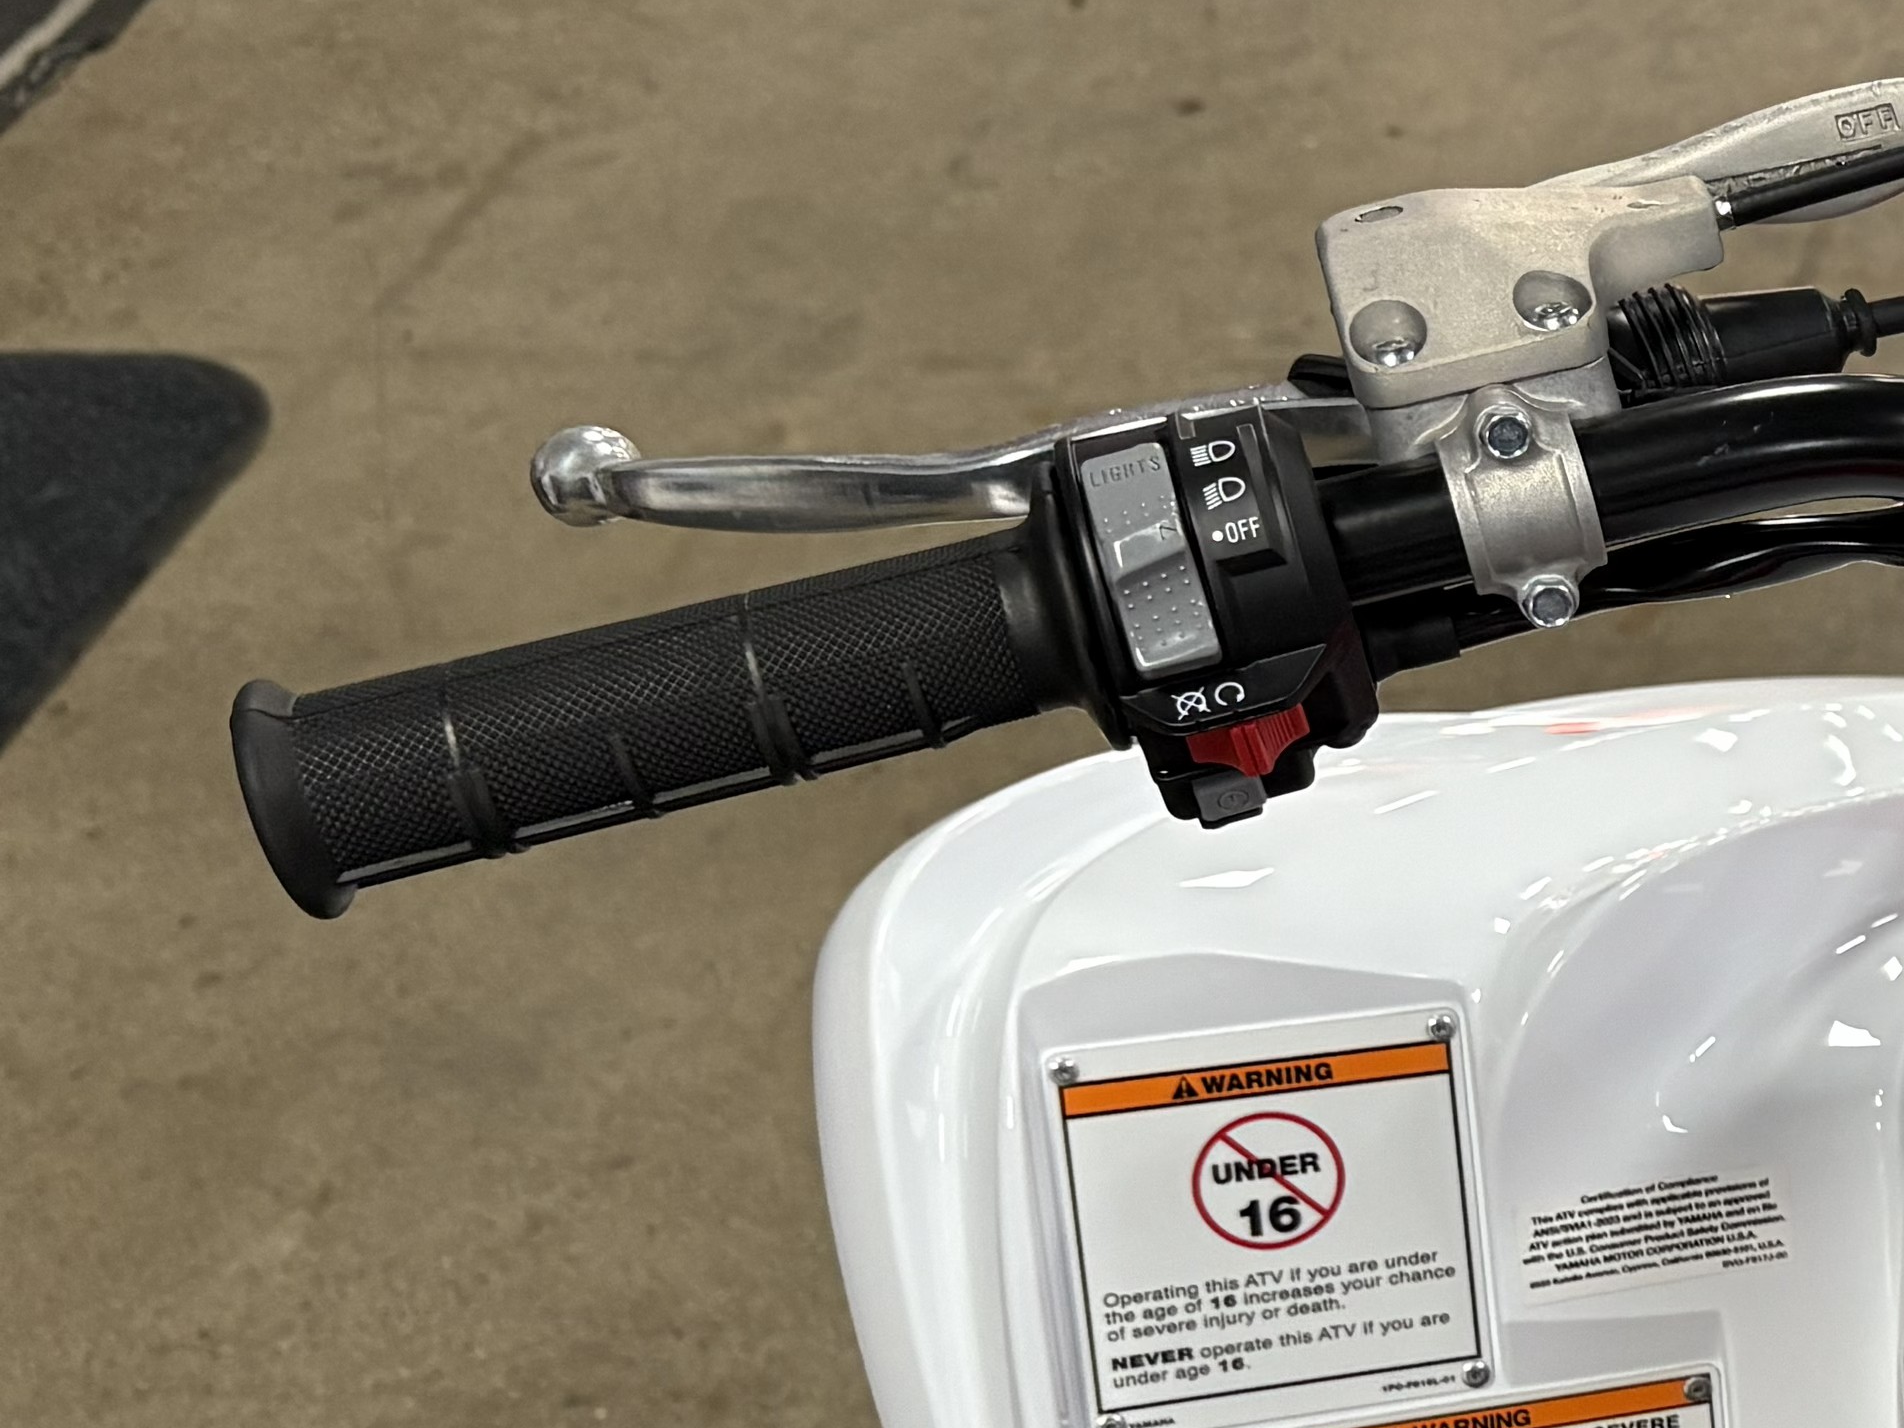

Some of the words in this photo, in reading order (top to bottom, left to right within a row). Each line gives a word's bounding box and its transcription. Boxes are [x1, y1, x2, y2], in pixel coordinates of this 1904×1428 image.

[1835, 103, 1900, 141] OFF
[1089, 454, 1163, 488] LIGHTS
[1225, 516, 1261, 544] OFF
[1201, 1061, 1334, 1095] WARNING
[1211, 1152, 1321, 1185] UNDER
[1239, 1196, 1303, 1237] 16
[1102, 1284, 1200, 1309] Operating
[1204, 1278, 1240, 1294] this
[1244, 1269, 1284, 1288] ATV
[1289, 1267, 1301, 1283] if
[1306, 1265, 1342, 1283] you
[1347, 1259, 1379, 1274] are
[1384, 1251, 1438, 1270] under
[1104, 1307, 1136, 1326] the
[1142, 1304, 1179, 1321] age
[1183, 1297, 1202, 1314] of
[1209, 1293, 1238, 1310] 16
[1243, 1282, 1336, 1306] increases
[1340, 1276, 1382, 1296] your
[1388, 1266, 1456, 1286] chance
[1106, 1325, 1126, 1343] of
[1131, 1319, 1198, 1339] severe
[1203, 1310, 1256, 1330] injury
[1261, 1307, 1281, 1321] or
[1286, 1297, 1346, 1318] death.
[1111, 1346, 1195, 1372] NEVER
[1199, 1338, 1273, 1359] operate
[1279, 1332, 1313, 1347] this
[1318, 1323, 1356, 1341] ATV
[1363, 1320, 1374, 1335] if
[1380, 1318, 1414, 1336] you
[1420, 1313, 1450, 1327] are
[1112, 1369, 1168, 1389] under
[1175, 1364, 1211, 1381] age
